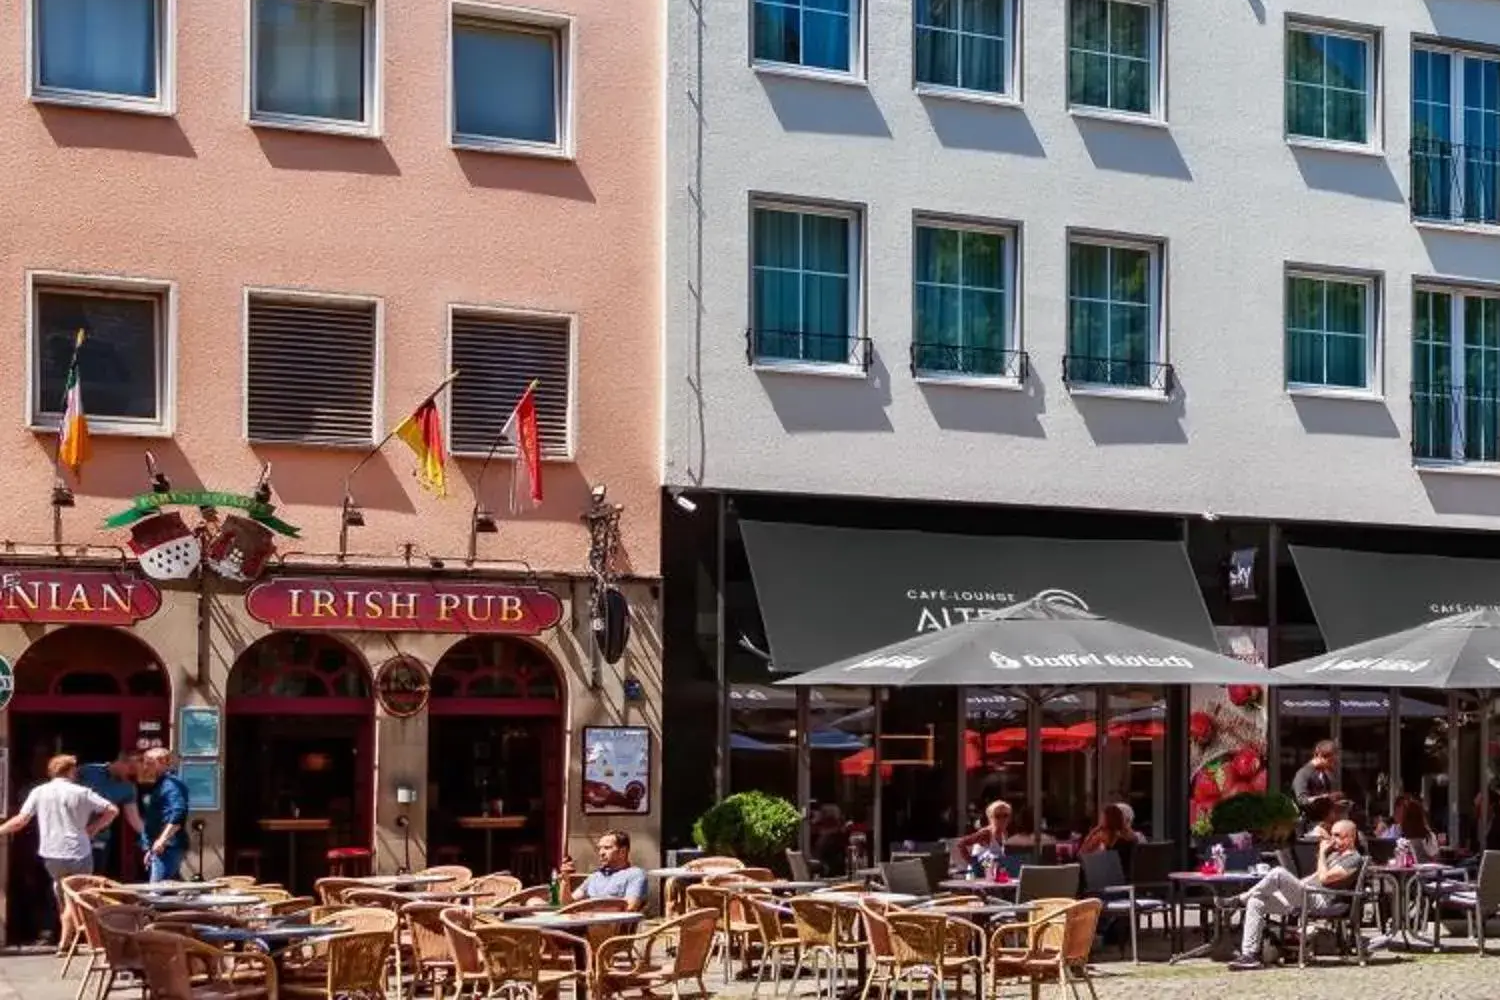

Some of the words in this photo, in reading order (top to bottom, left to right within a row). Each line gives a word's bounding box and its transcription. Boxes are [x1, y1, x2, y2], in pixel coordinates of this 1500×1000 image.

[0, 581, 136, 613] NIAN
[287, 588, 421, 619] IRISH
[434, 593, 524, 621] PUB
